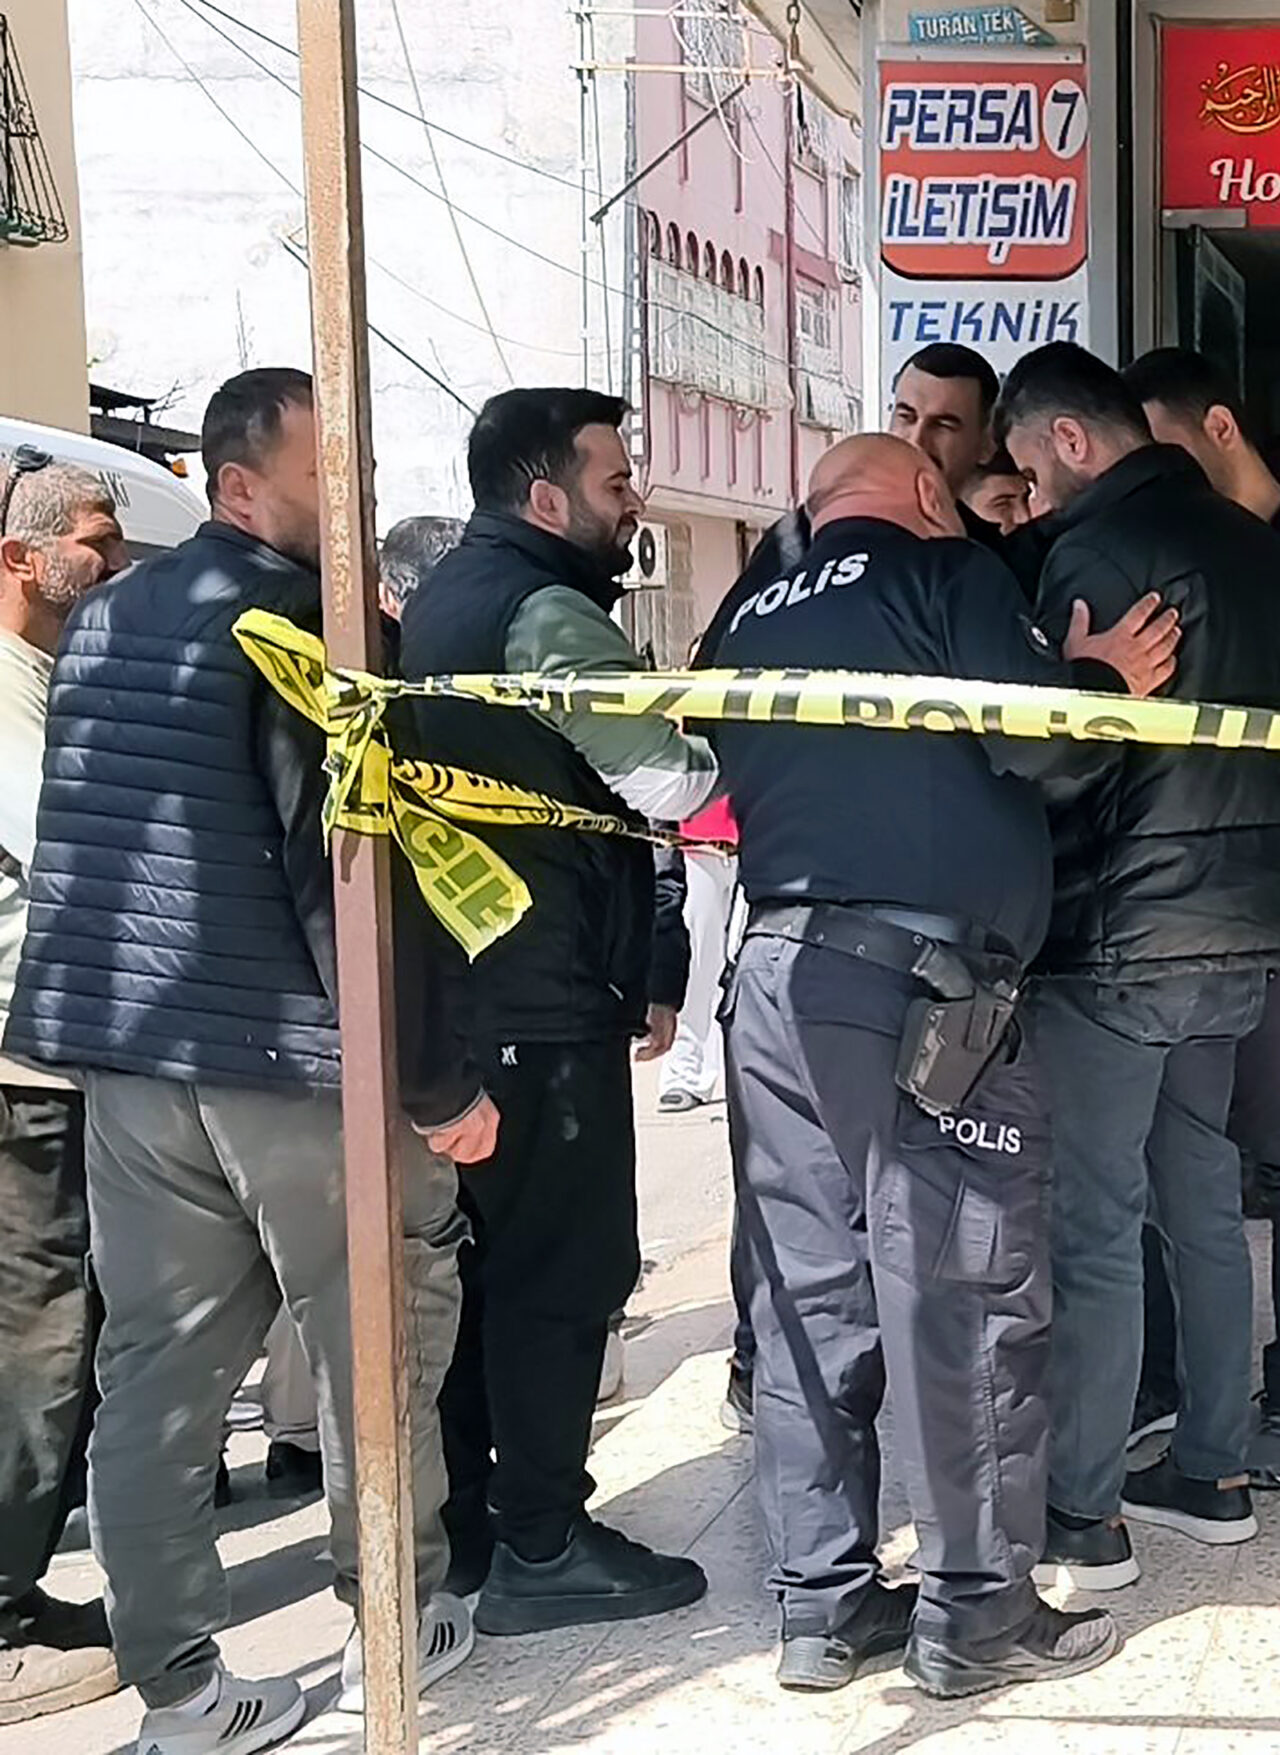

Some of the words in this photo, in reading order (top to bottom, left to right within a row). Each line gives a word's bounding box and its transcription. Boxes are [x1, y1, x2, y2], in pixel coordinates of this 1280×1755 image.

[916, 15, 977, 39] TURAN
[884, 88, 1034, 145] PERSA
[1051, 90, 1080, 151] 7
